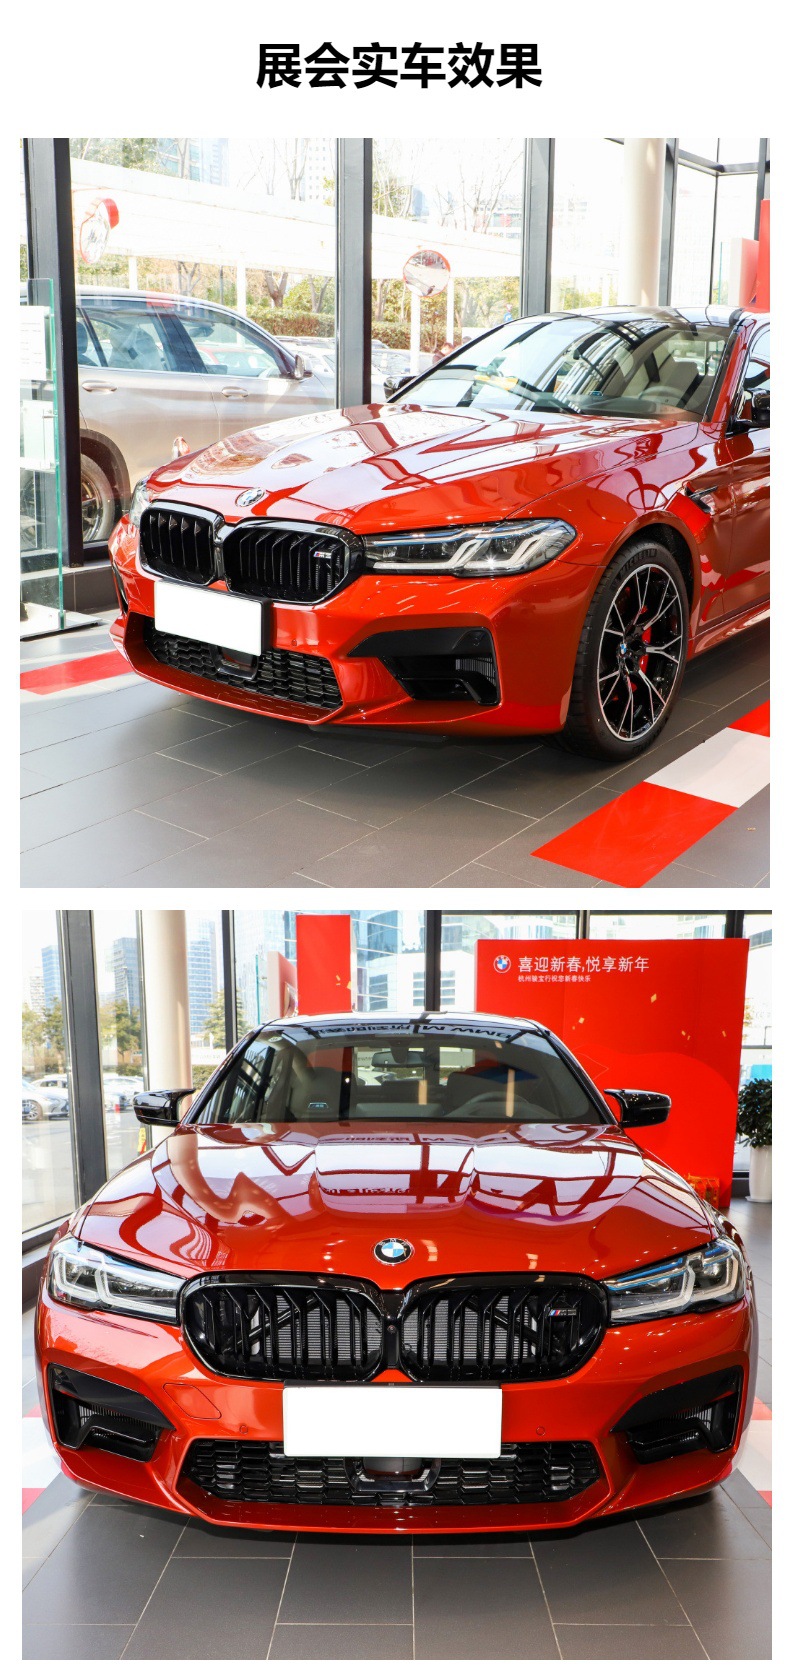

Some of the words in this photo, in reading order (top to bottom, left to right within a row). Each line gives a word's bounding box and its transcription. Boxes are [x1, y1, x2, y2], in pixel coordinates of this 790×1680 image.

[518, 956, 649, 973] 喜迎新春,悦享新年
